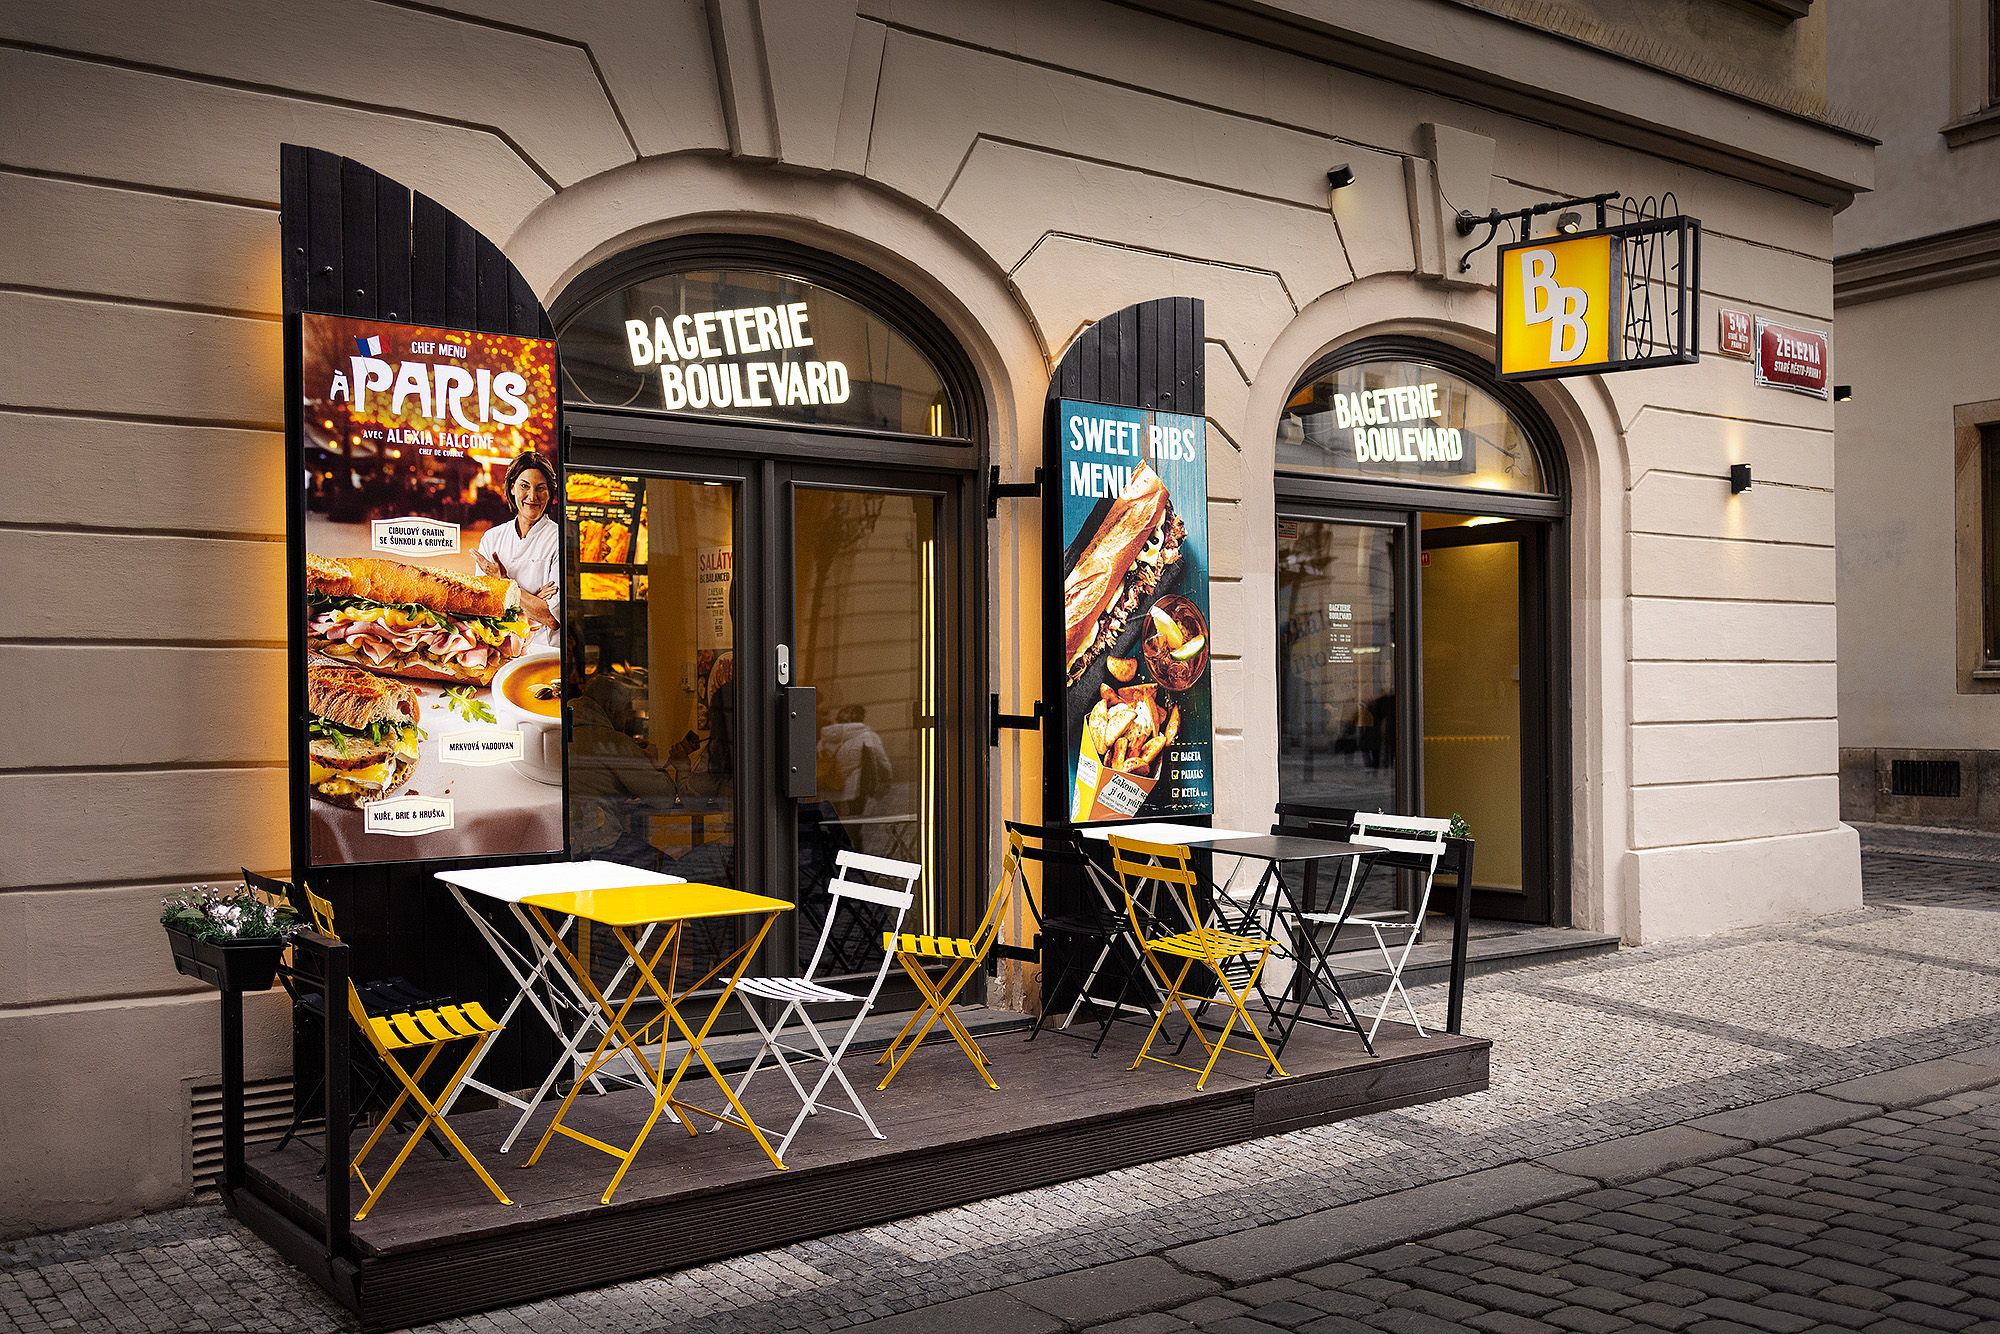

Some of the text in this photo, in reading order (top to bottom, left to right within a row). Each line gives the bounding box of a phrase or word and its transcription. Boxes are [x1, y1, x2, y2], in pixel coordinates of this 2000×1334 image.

[1729, 313, 1749, 333] 544
[625, 302, 814, 366] BAGETERIE
[1728, 332, 1738, 340] STARÉ
[411, 341, 467, 359] CHEF MENU
[1776, 333, 1820, 364] ŽELEZNÁ
[1774, 360, 1790, 373] STARÉ
[330, 356, 529, 432] À PARIS
[660, 361, 850, 410] BOULEVARD
[1334, 383, 1442, 429] BAGETERIE
[362, 428, 495, 450] AVEC ALEXIA FALCONE
[1069, 415, 1196, 463] SWEET RIBS
[1353, 427, 1463, 463] BOULEVARD
[1070, 460, 1132, 500] MENU
[379, 536, 388, 544] SE
[390, 535, 416, 546] ŠUNKOU
[418, 537, 423, 546] A
[388, 525, 445, 537] CIBULOVÝ GRATIN
[700, 549, 732, 571] SALÁTY
[449, 740, 480, 751] MRKVOVÁ
[1180, 751, 1201, 762] BAGETA
[1181, 769, 1204, 779] PATATAS
[1116, 791, 1127, 802] do
[1182, 787, 1200, 797] ICETEA
[374, 808, 445, 821] KUŘE, BRIE & HRUŠKA
